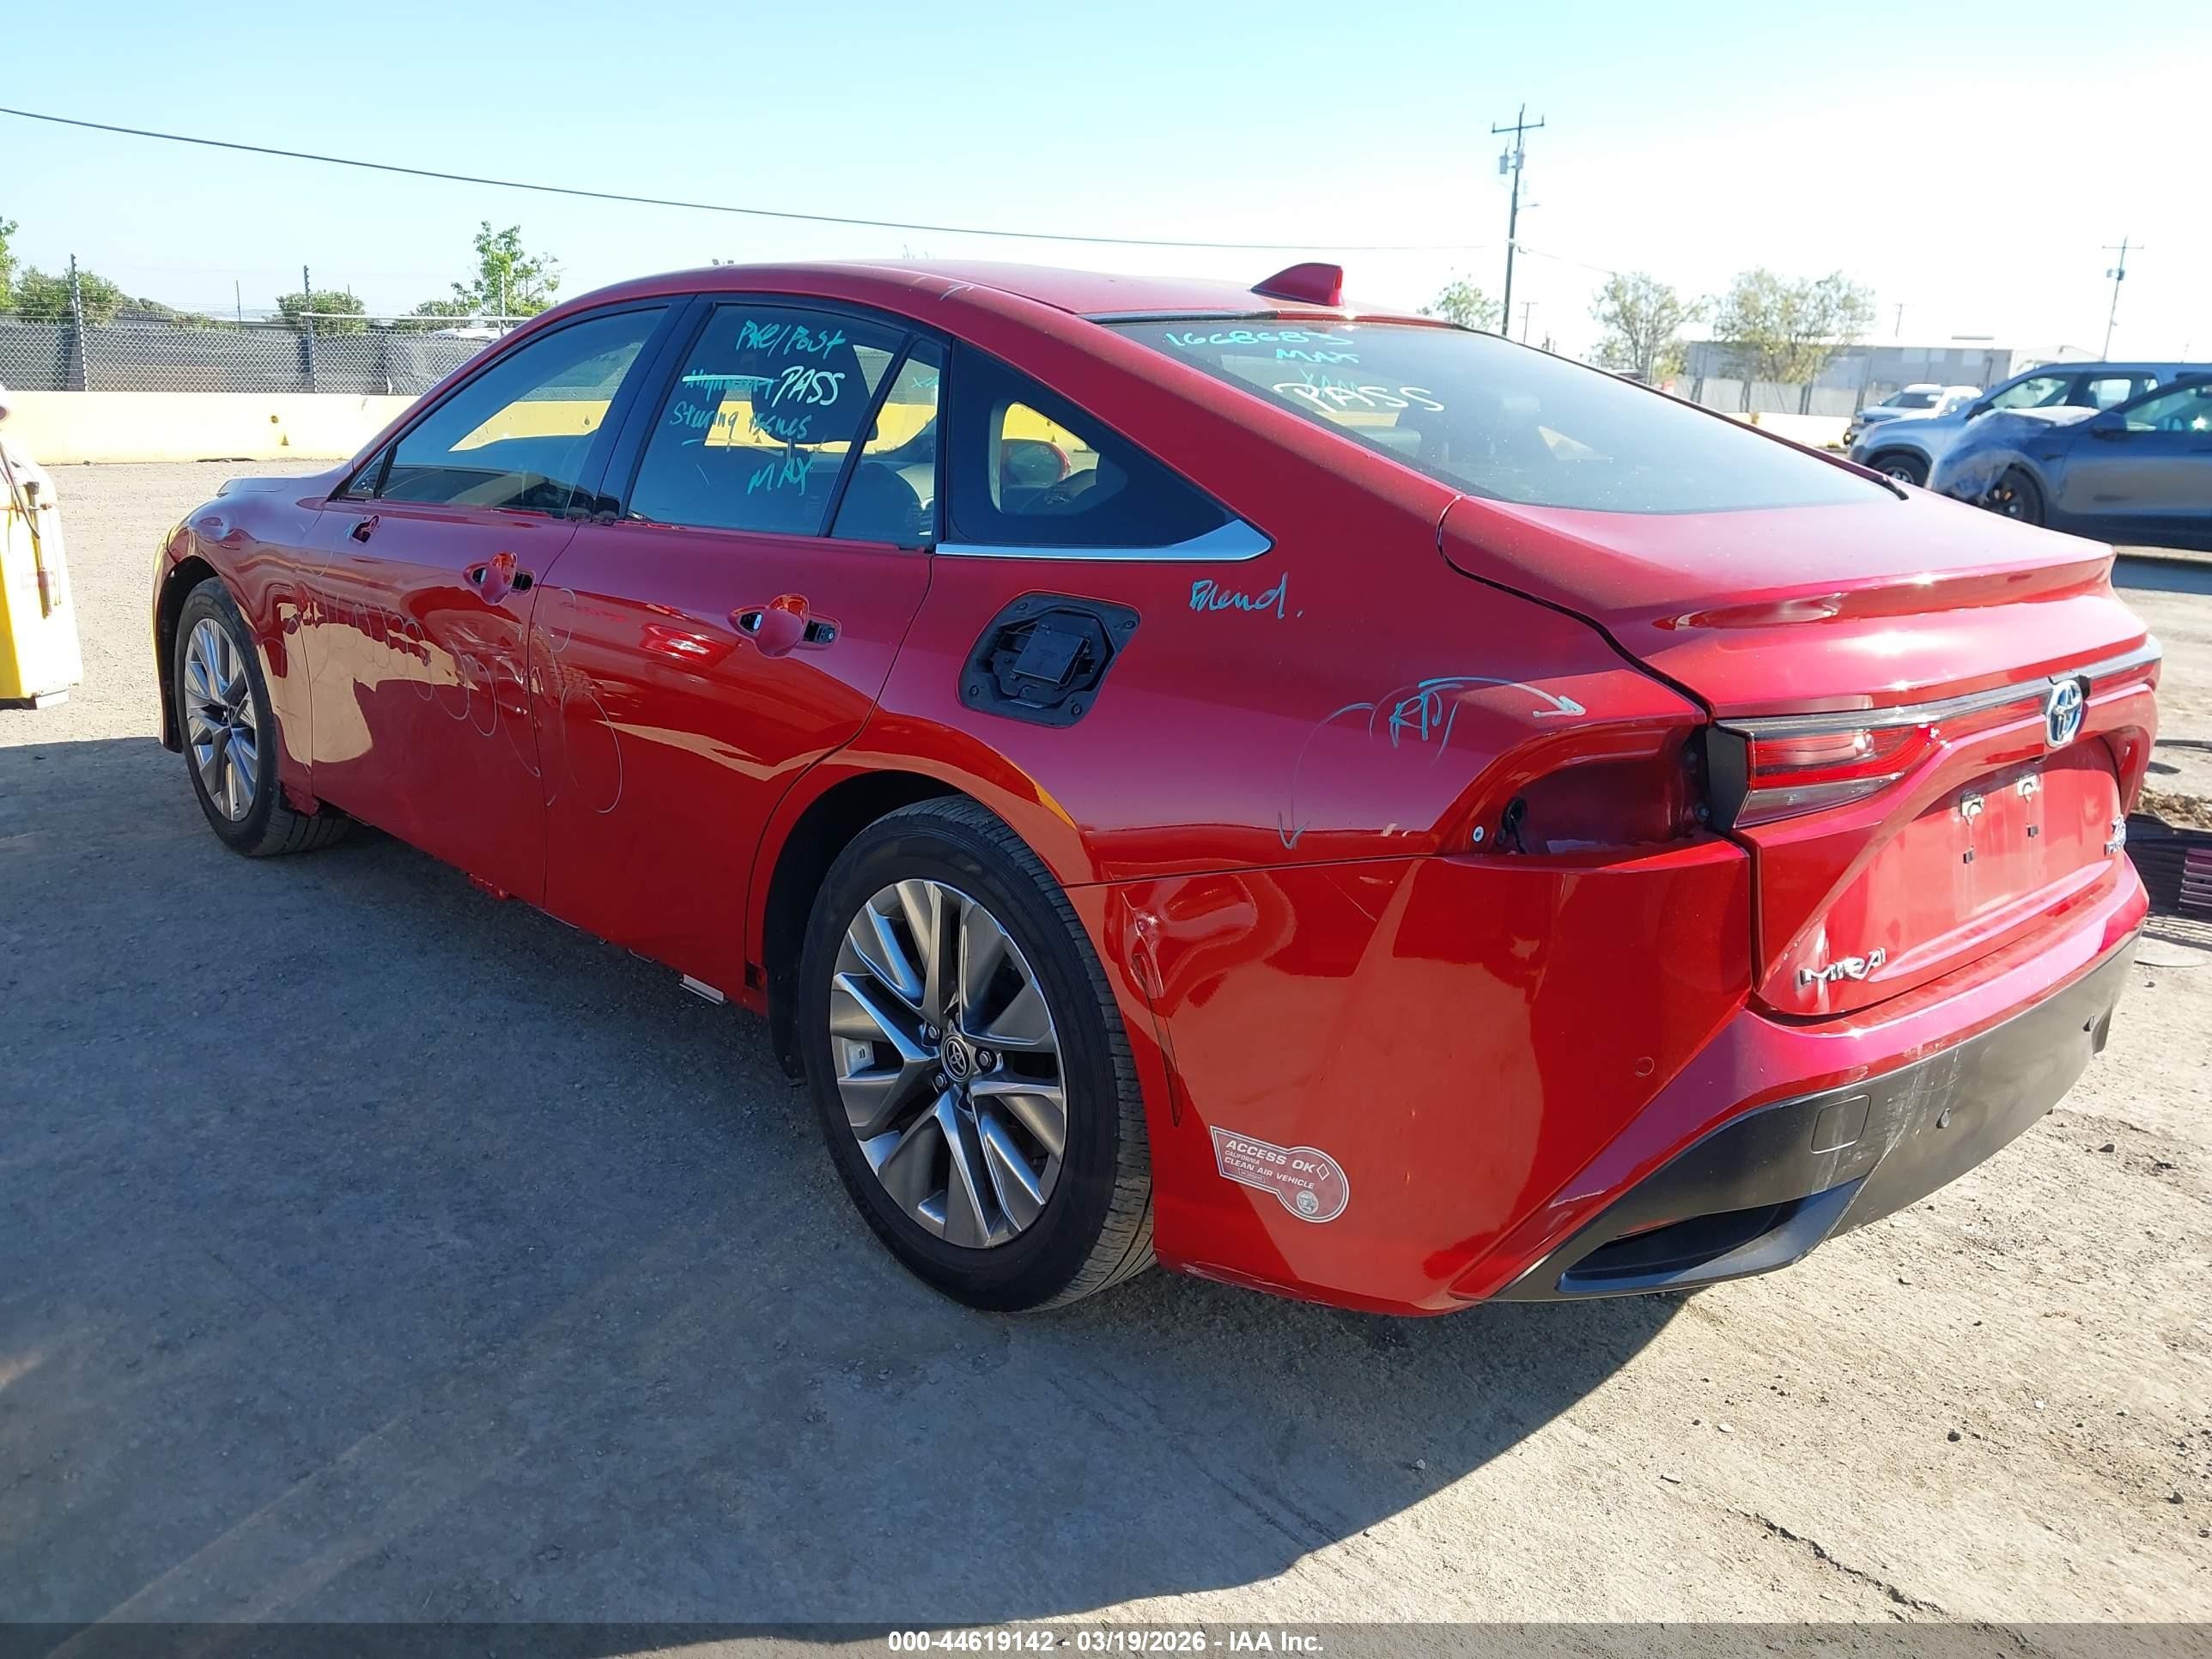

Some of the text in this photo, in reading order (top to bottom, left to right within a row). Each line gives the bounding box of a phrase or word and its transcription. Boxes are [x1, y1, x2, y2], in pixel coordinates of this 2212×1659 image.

[771, 365, 846, 408] PASS
[1273, 383, 1445, 413] PASS
[1224, 1150, 1260, 1165] CALIFORNIA
[1225, 1139, 1316, 1174] ACCESS OK
[1224, 1157, 1255, 1171] CLEAN
[1256, 1167, 1273, 1177] AIR
[1276, 1173, 1316, 1189] VEHICLE
